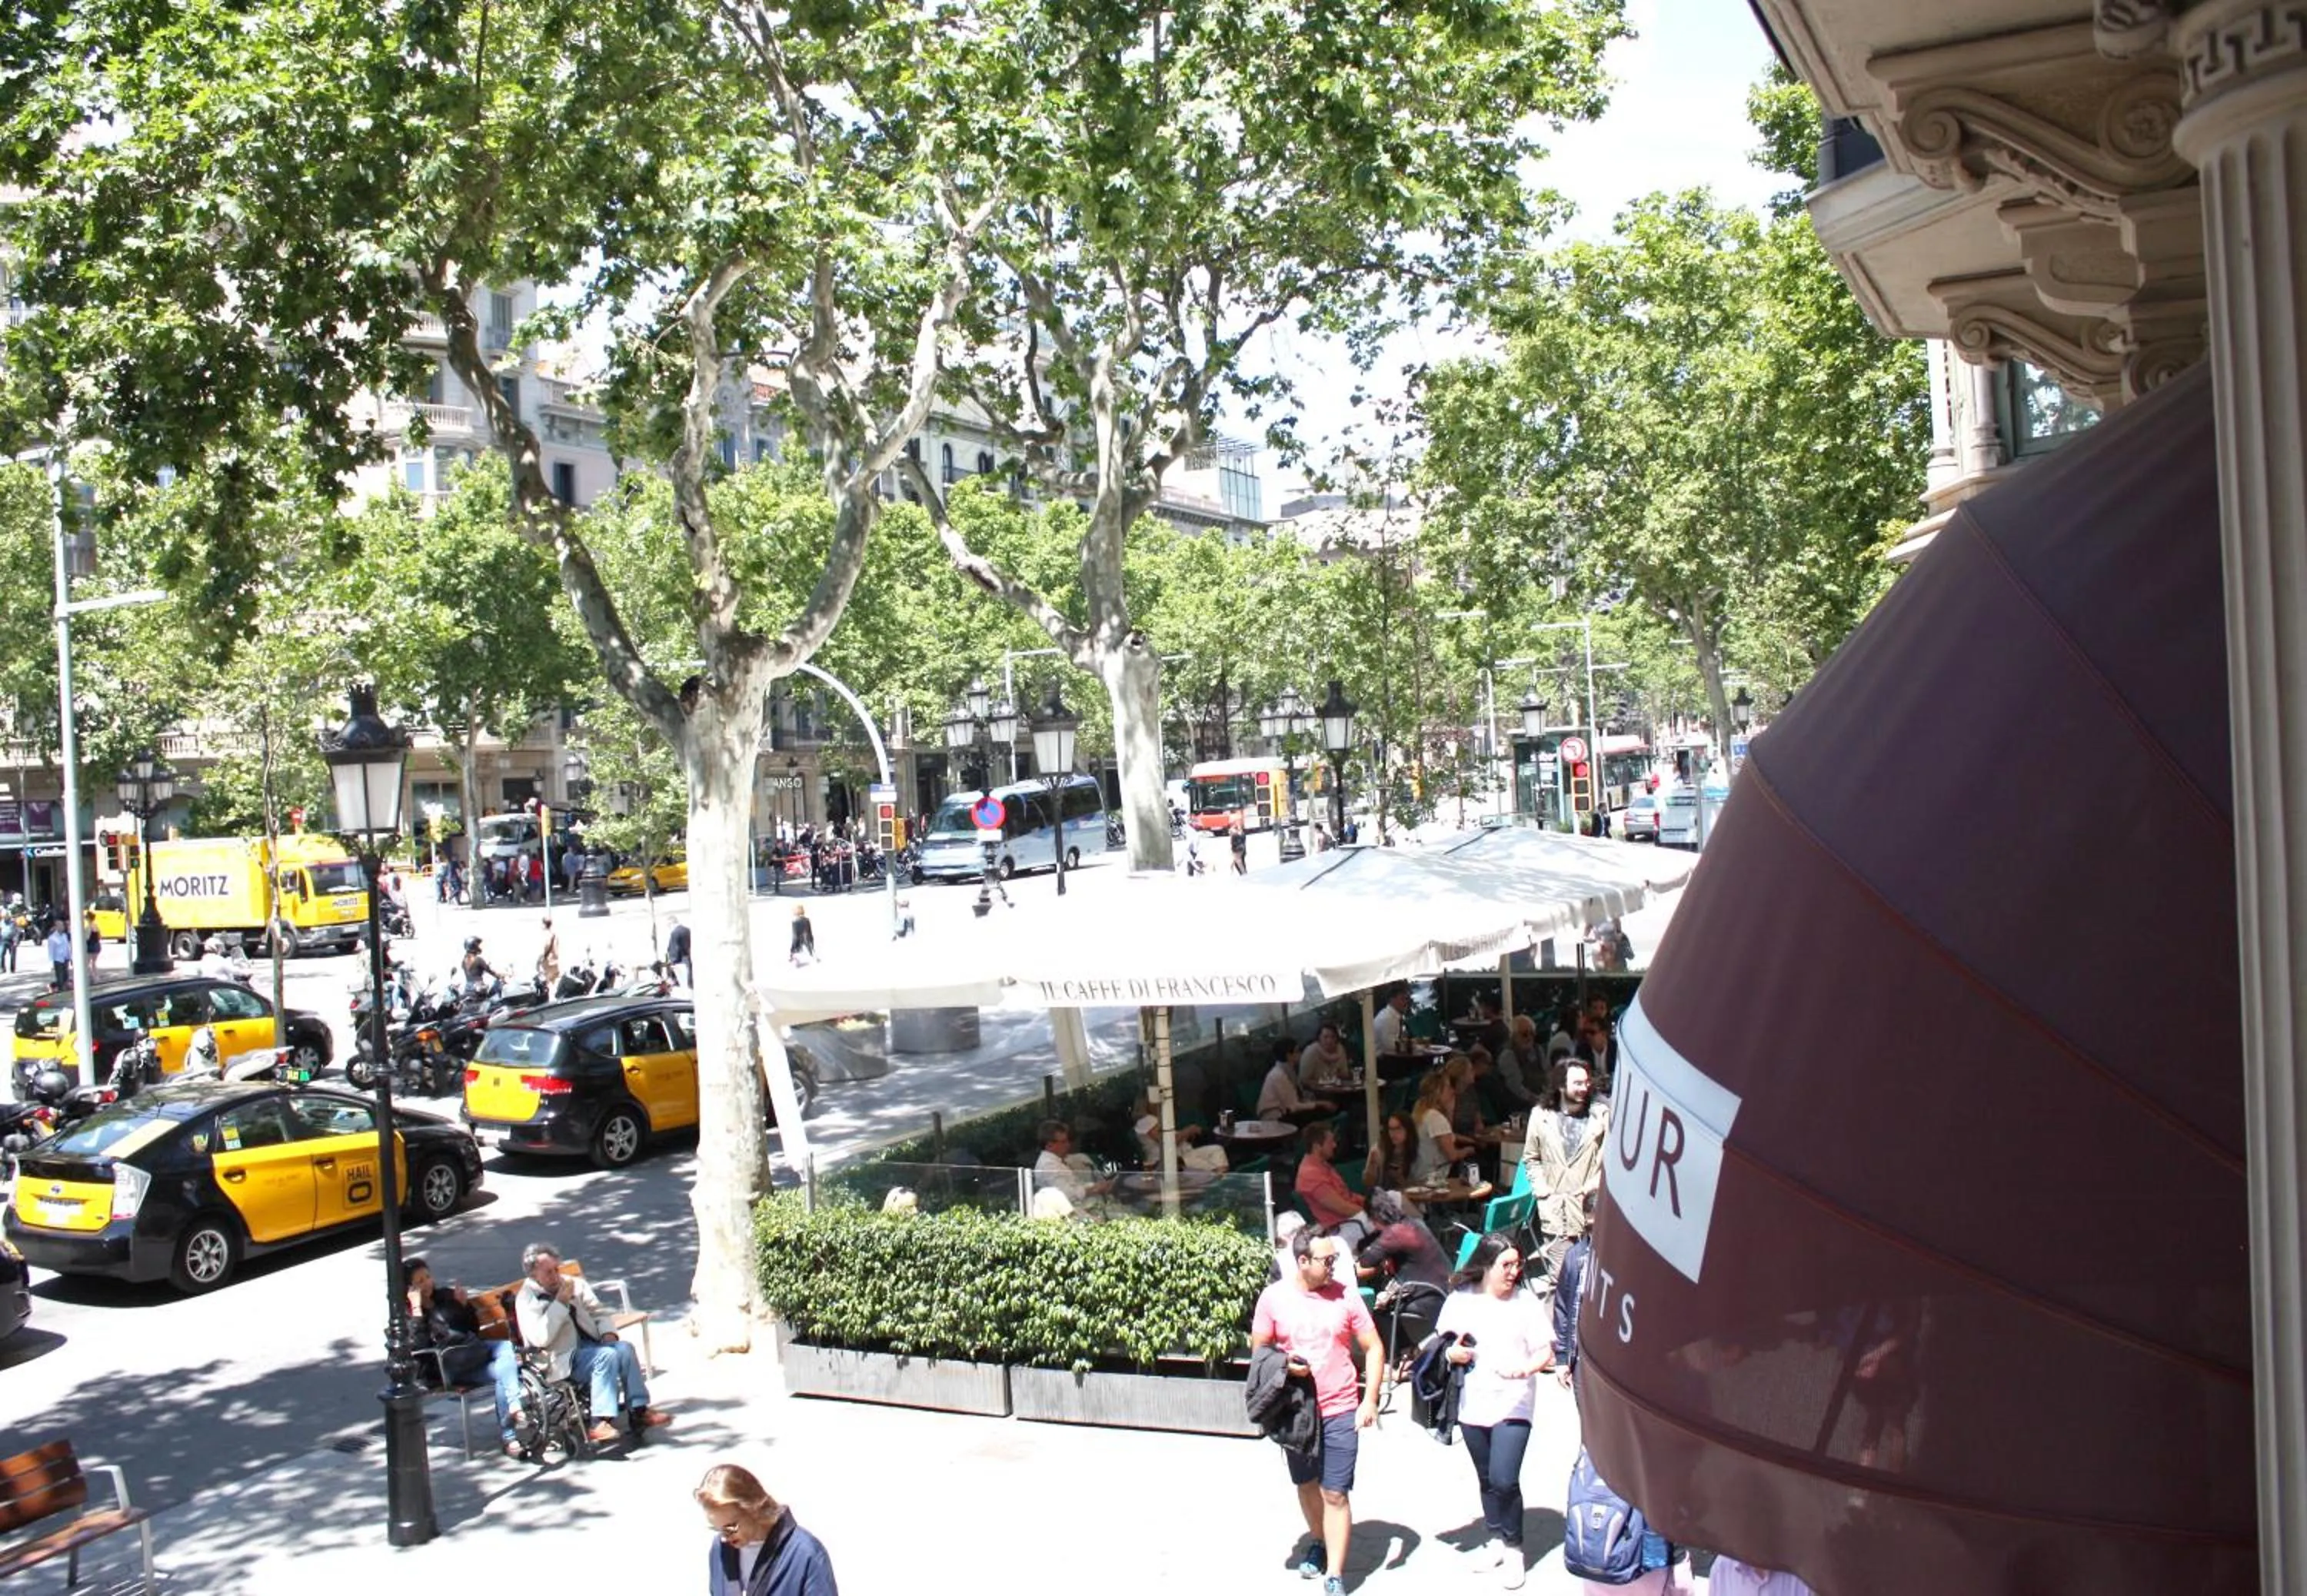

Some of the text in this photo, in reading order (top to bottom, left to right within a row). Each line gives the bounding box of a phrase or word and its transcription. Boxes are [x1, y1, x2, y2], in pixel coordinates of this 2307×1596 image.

[772, 776, 802, 789] ANGO
[159, 875, 229, 897] MORITZ
[1127, 978, 1151, 999] DI
[1155, 973, 1277, 999] FRANCESCO
